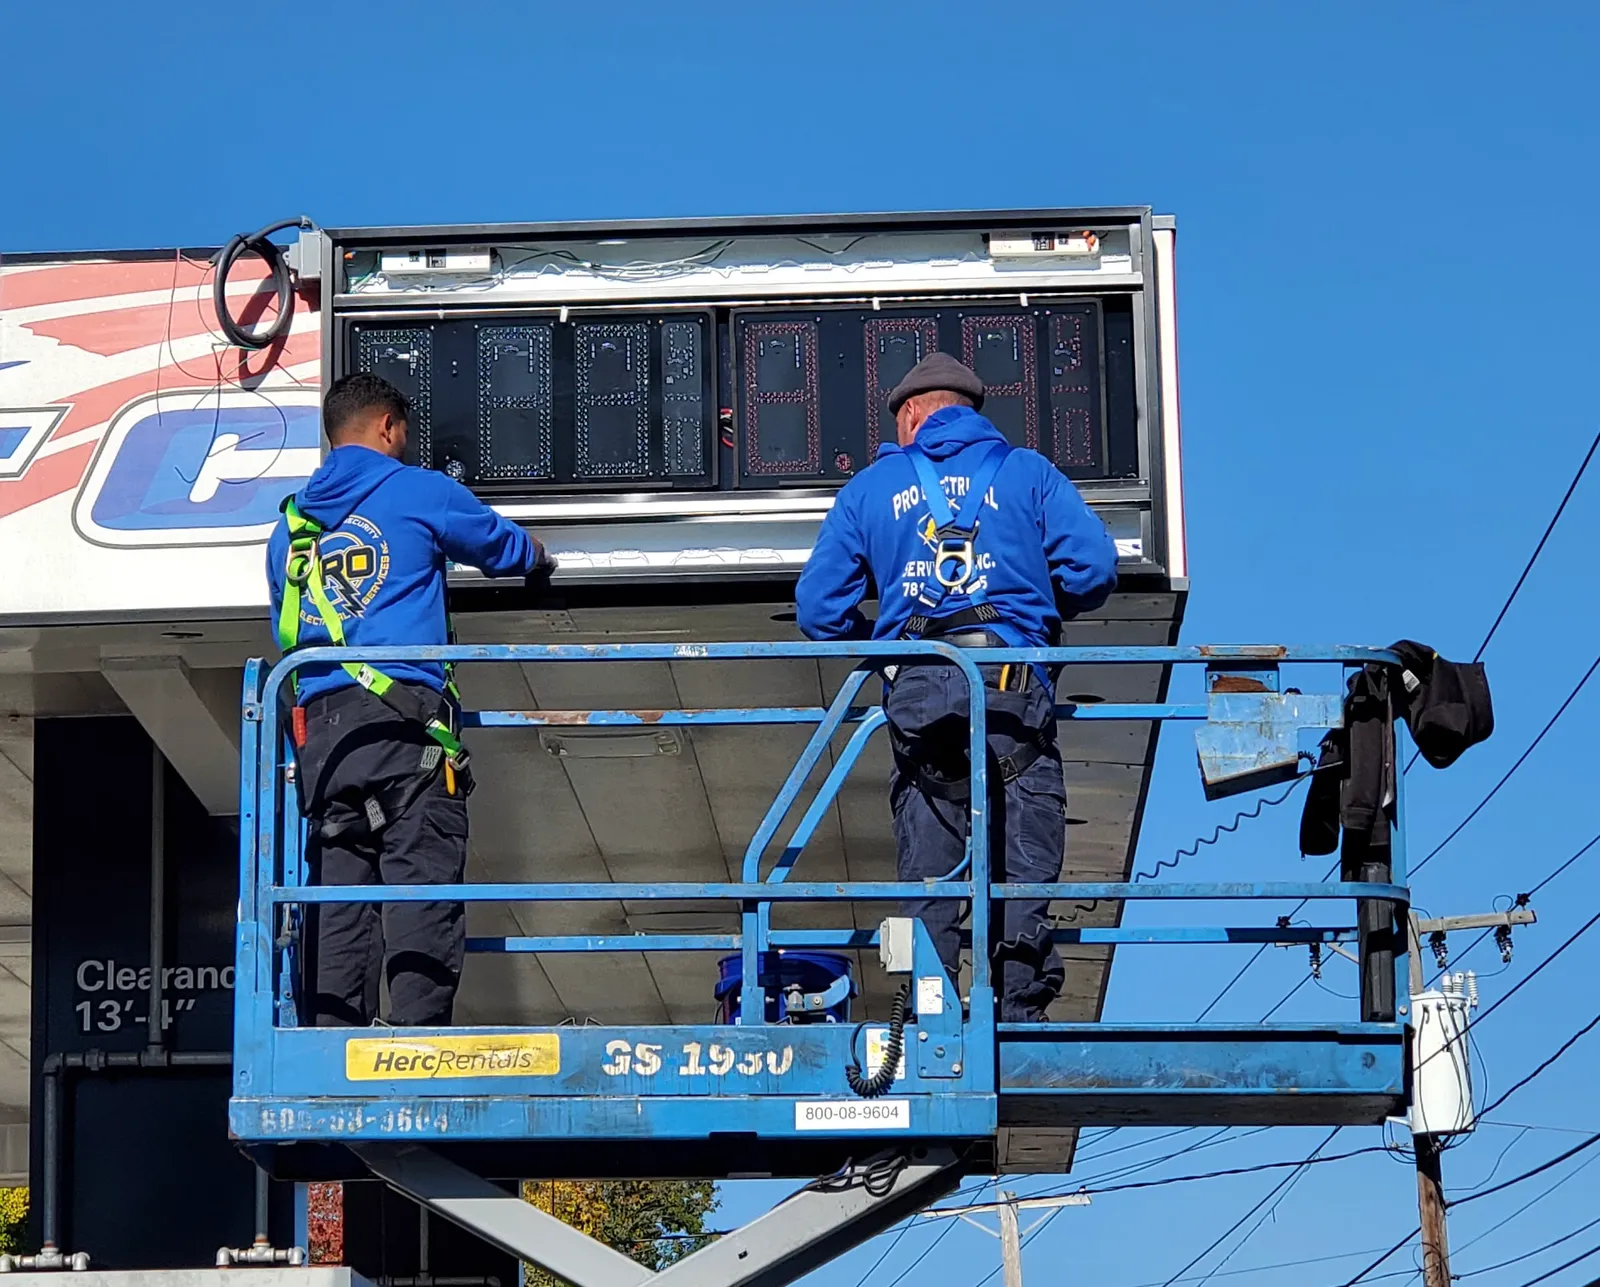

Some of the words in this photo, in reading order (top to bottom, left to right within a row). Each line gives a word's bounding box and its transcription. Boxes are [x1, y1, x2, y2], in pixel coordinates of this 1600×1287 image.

[893, 484, 919, 521] PRO
[361, 555, 390, 606] SERVICES
[76, 959, 236, 992] Clearanc
[602, 1039, 662, 1076] GS
[805, 1105, 899, 1121] 800-08-9604
